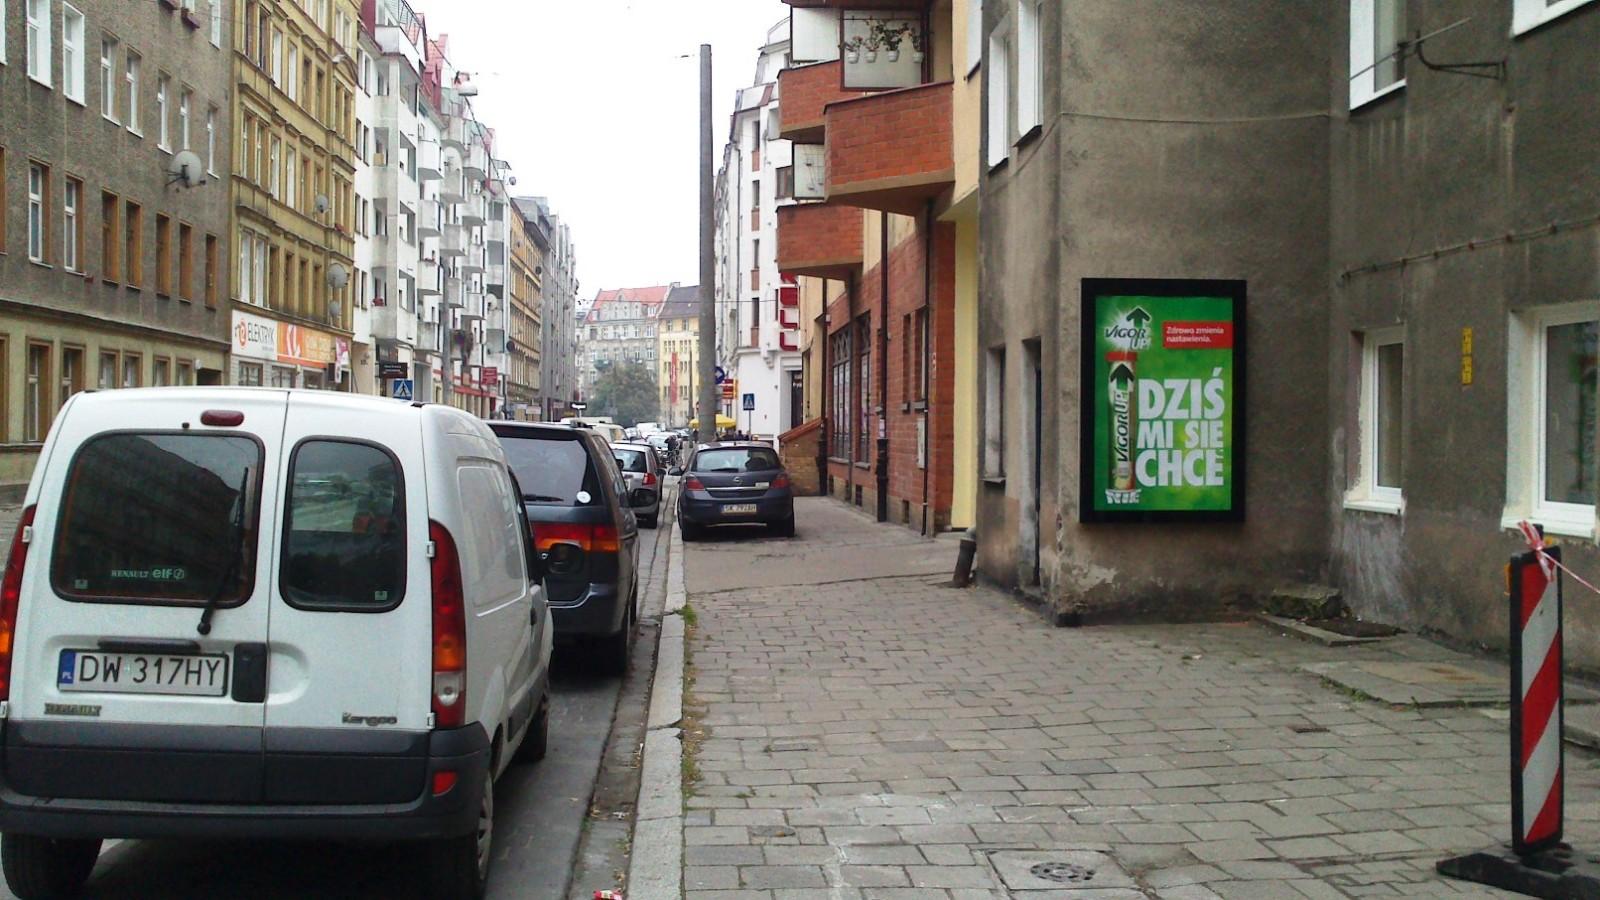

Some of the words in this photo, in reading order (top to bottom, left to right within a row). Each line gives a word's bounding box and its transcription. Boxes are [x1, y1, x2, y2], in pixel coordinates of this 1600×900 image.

[248, 322, 275, 343] ELEKTRYK
[1105, 325, 1146, 338] VIGOR
[1166, 335, 1211, 343] nastawienia.
[1138, 367, 1225, 420] DZIŚ
[1137, 420, 1174, 449] MI
[1135, 449, 1224, 487] CHCE
[110, 569, 149, 579] RENAULT
[152, 567, 173, 579] elf
[79, 655, 122, 683] DW
[132, 658, 222, 686] 317HY
